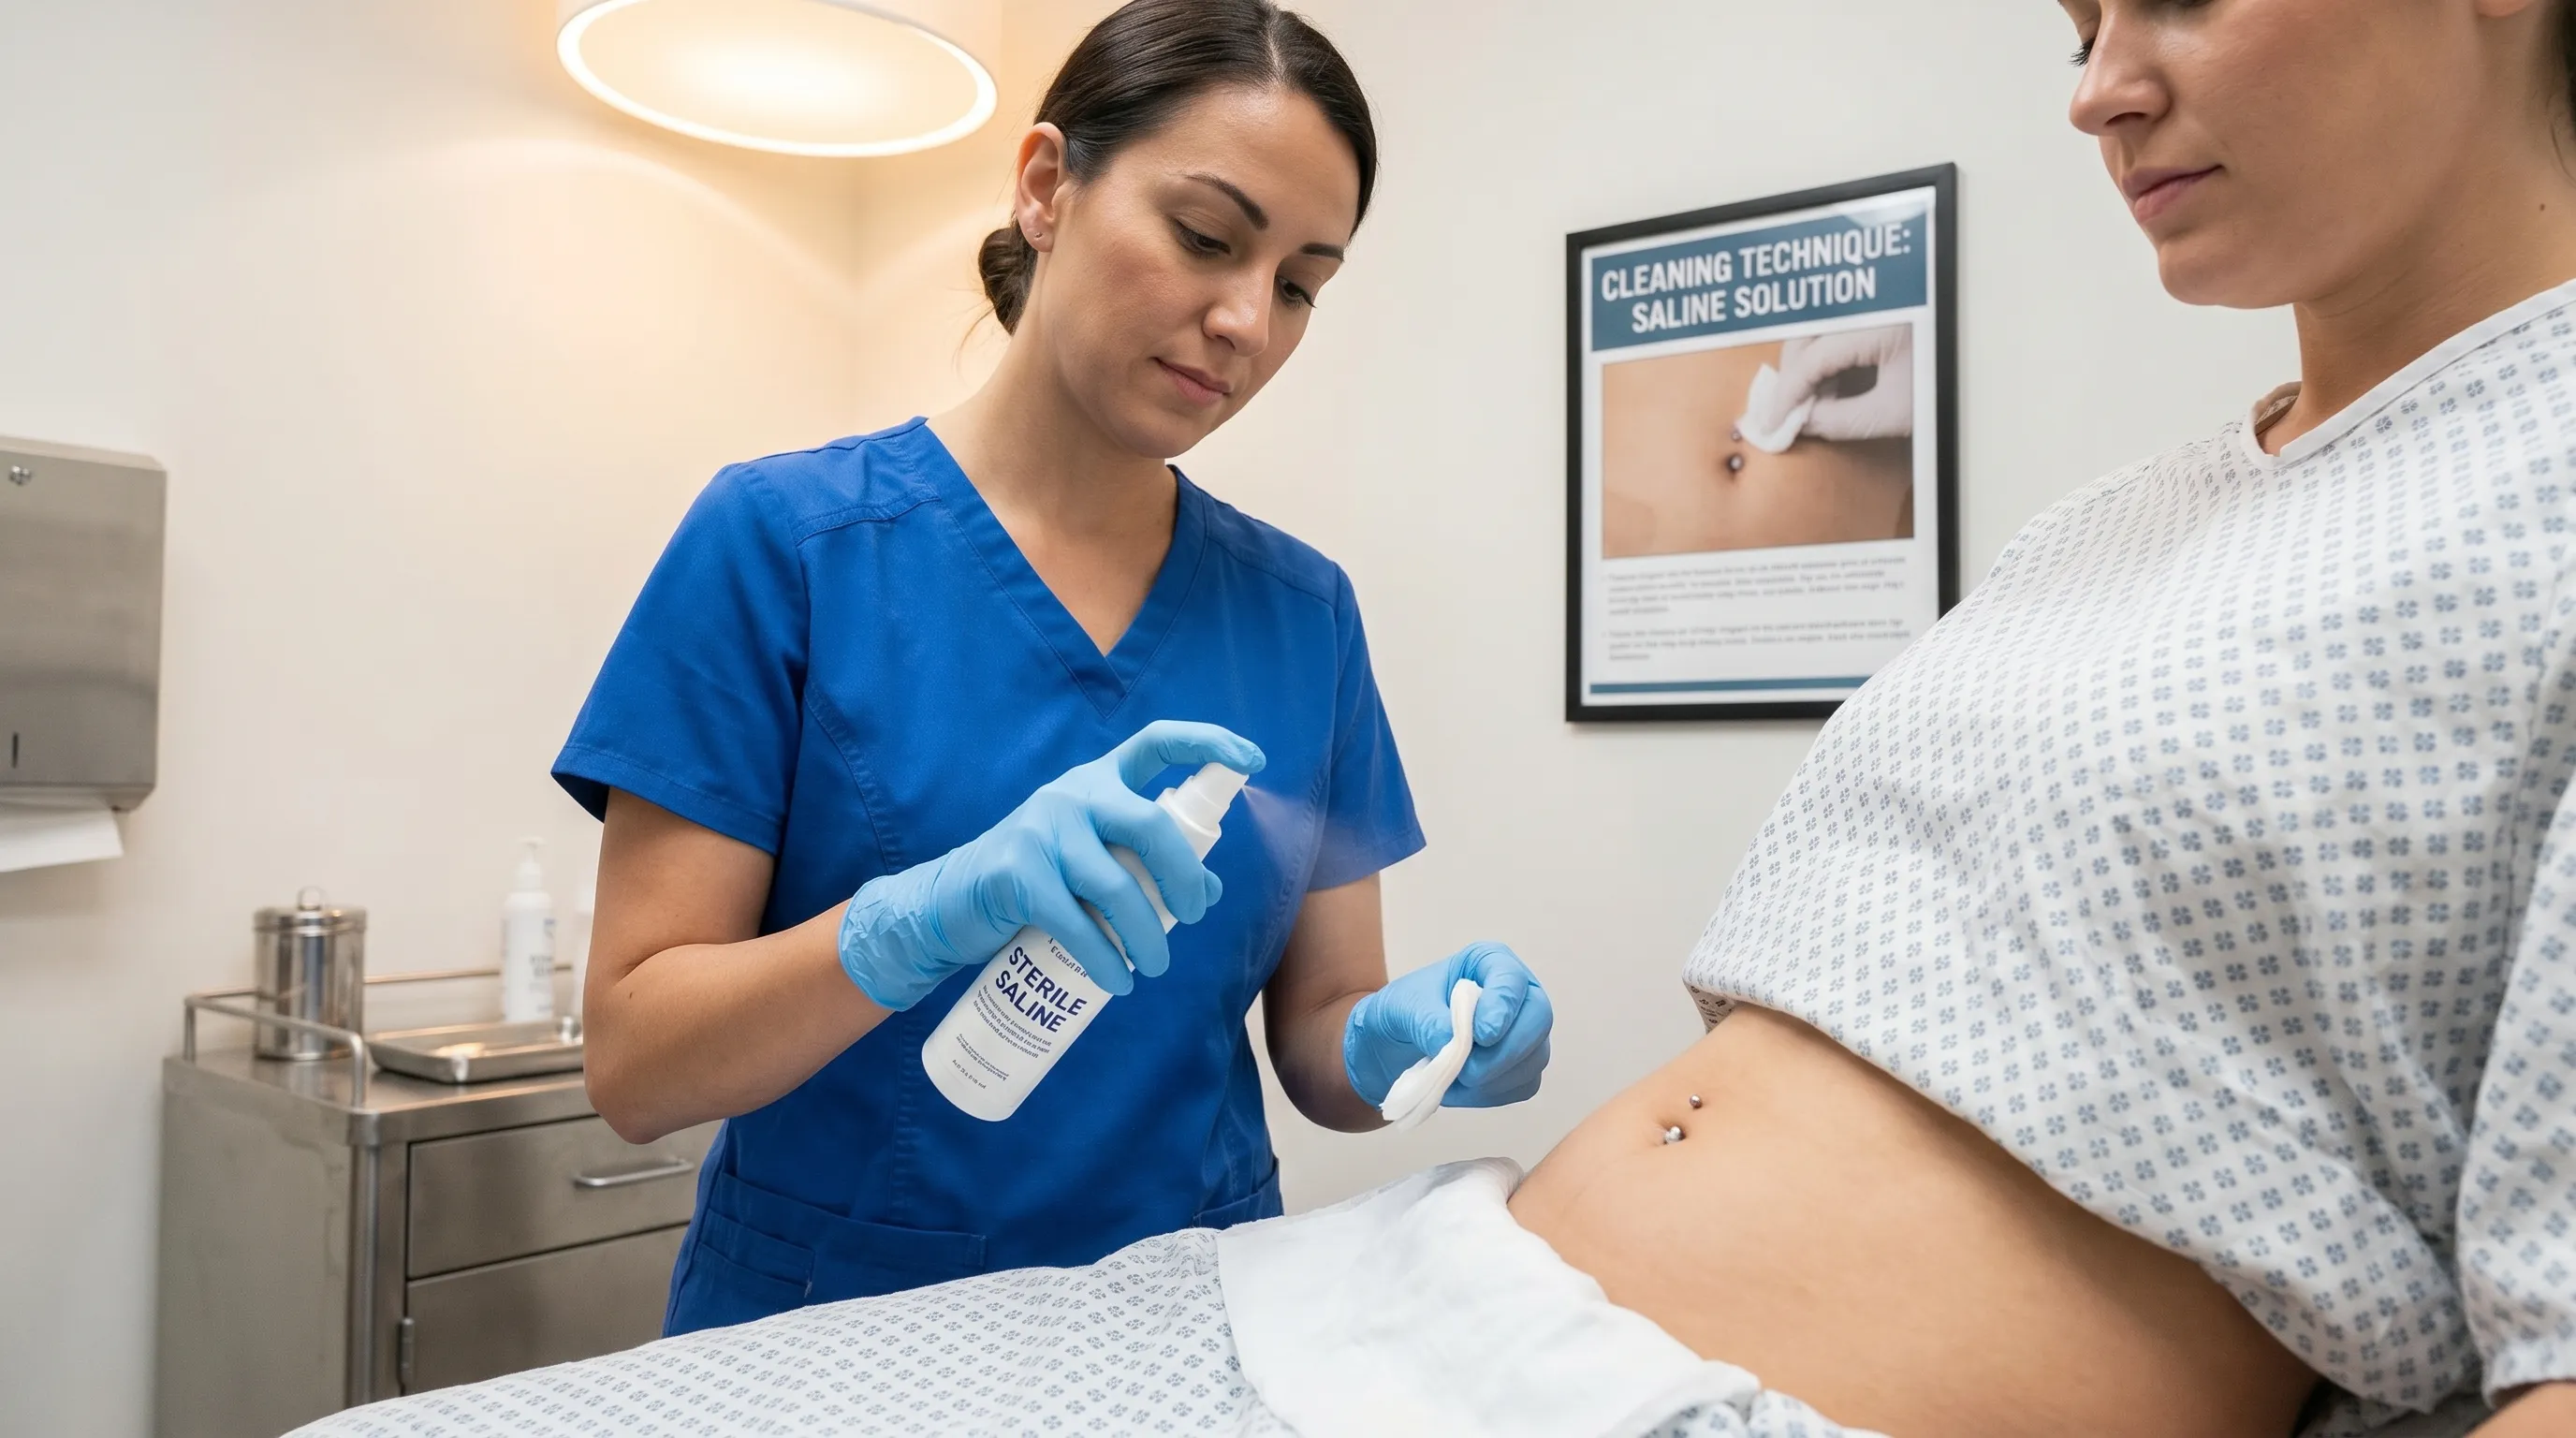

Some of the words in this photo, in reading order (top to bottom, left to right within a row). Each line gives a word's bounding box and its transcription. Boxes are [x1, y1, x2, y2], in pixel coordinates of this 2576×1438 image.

[1602, 251, 1732, 301] CLEANING
[1738, 221, 1911, 278] TECHNIQUE:
[1632, 290, 1726, 333] SALINE
[1734, 267, 1876, 318] SOLUTION
[995, 970, 1067, 1033] SALINE
[1009, 946, 1088, 1016] STERILE
